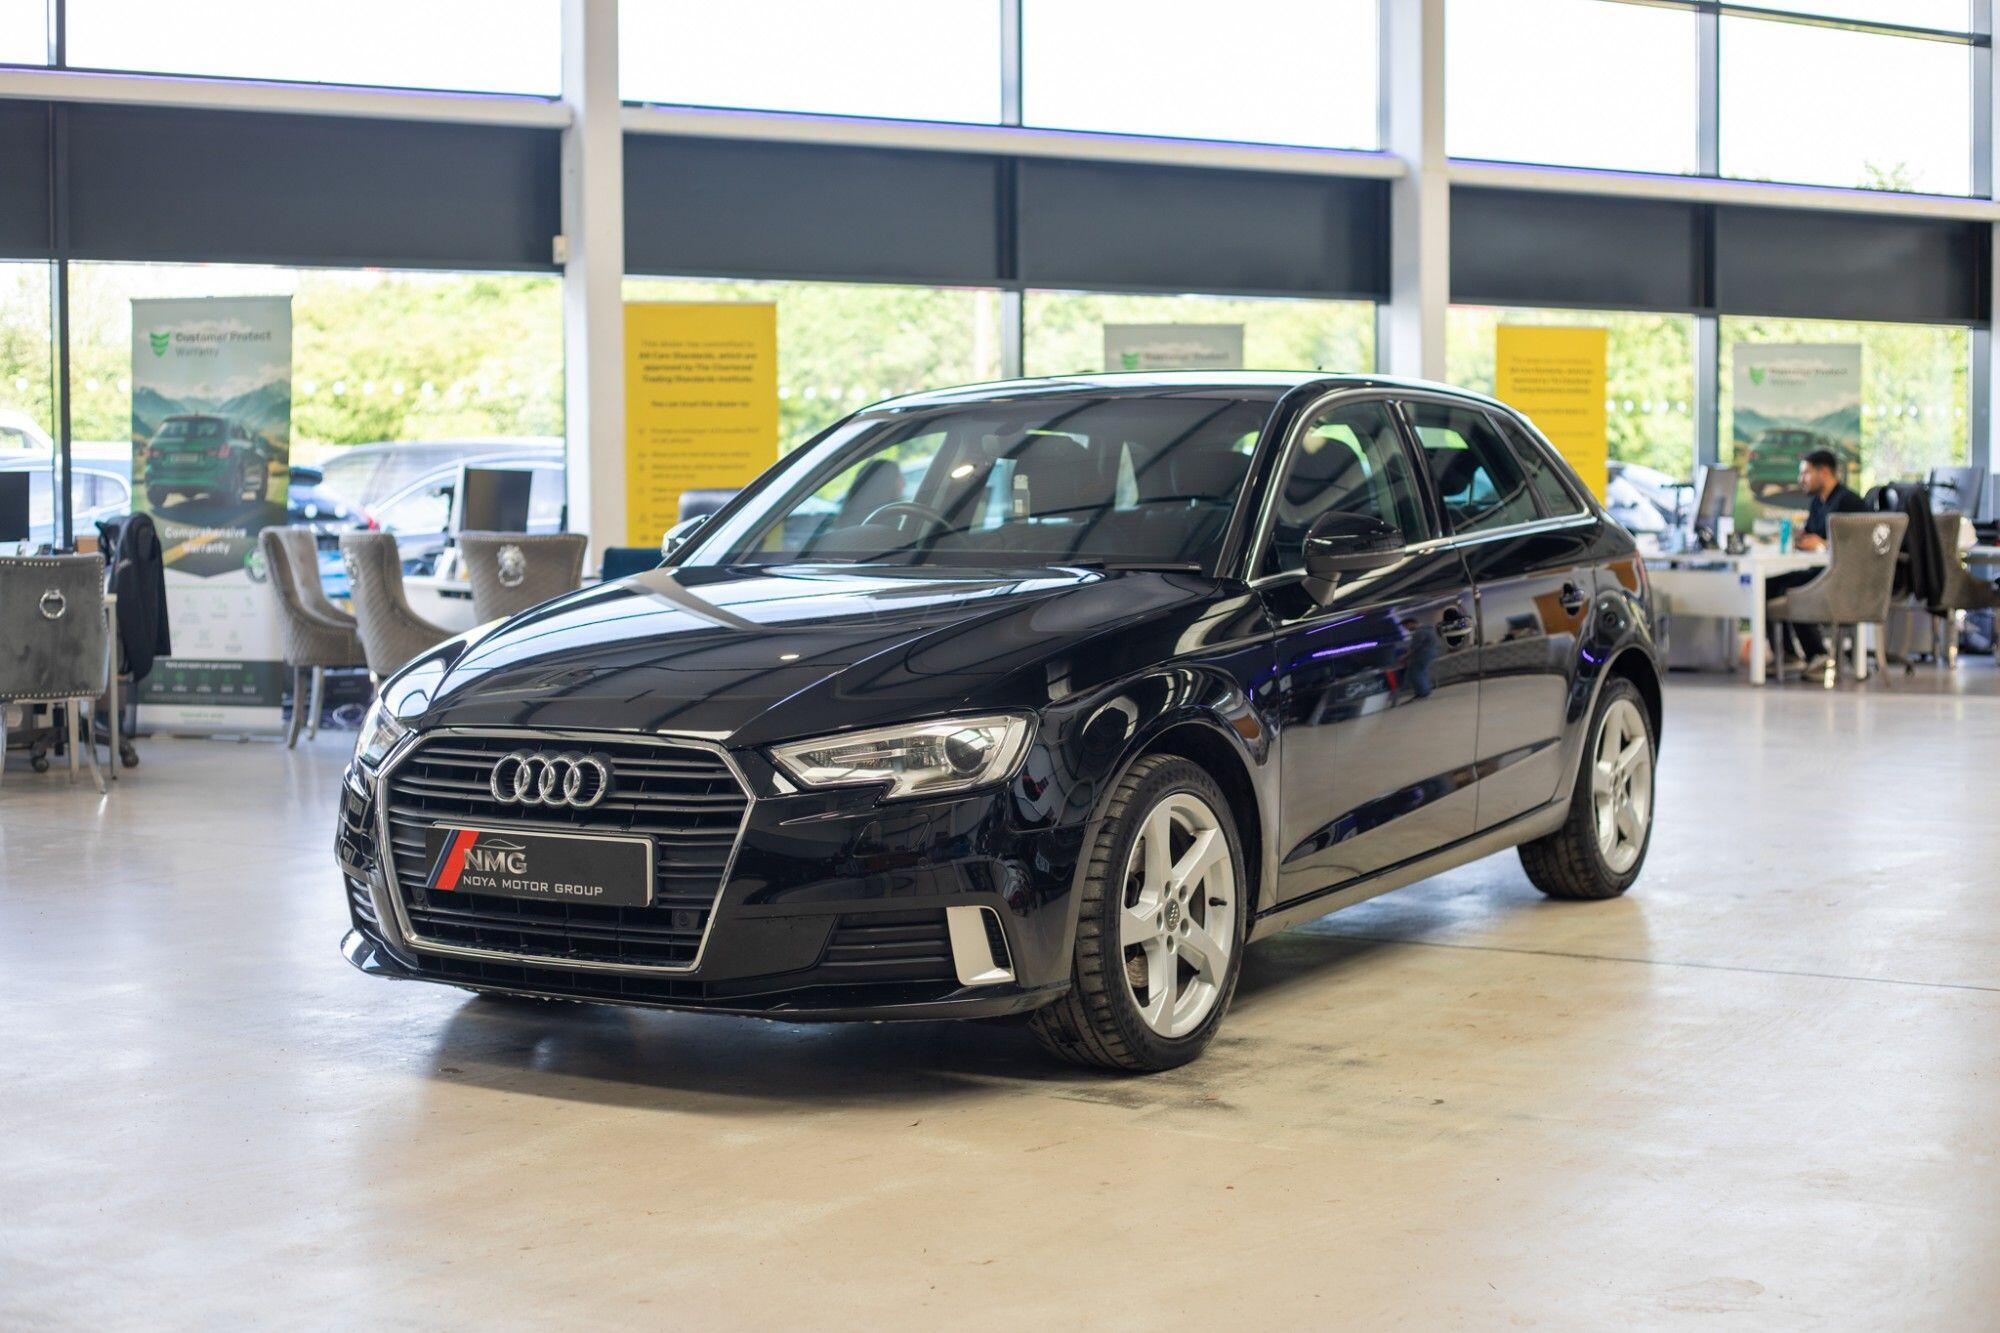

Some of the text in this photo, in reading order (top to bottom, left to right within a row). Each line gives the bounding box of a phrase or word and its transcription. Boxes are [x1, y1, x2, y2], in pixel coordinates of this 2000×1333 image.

[164, 526, 247, 541] Comprehensive
[182, 541, 231, 556] Warranty
[463, 847, 528, 875] NMG
[463, 875, 604, 897] NOYA MOTOR GROUP
